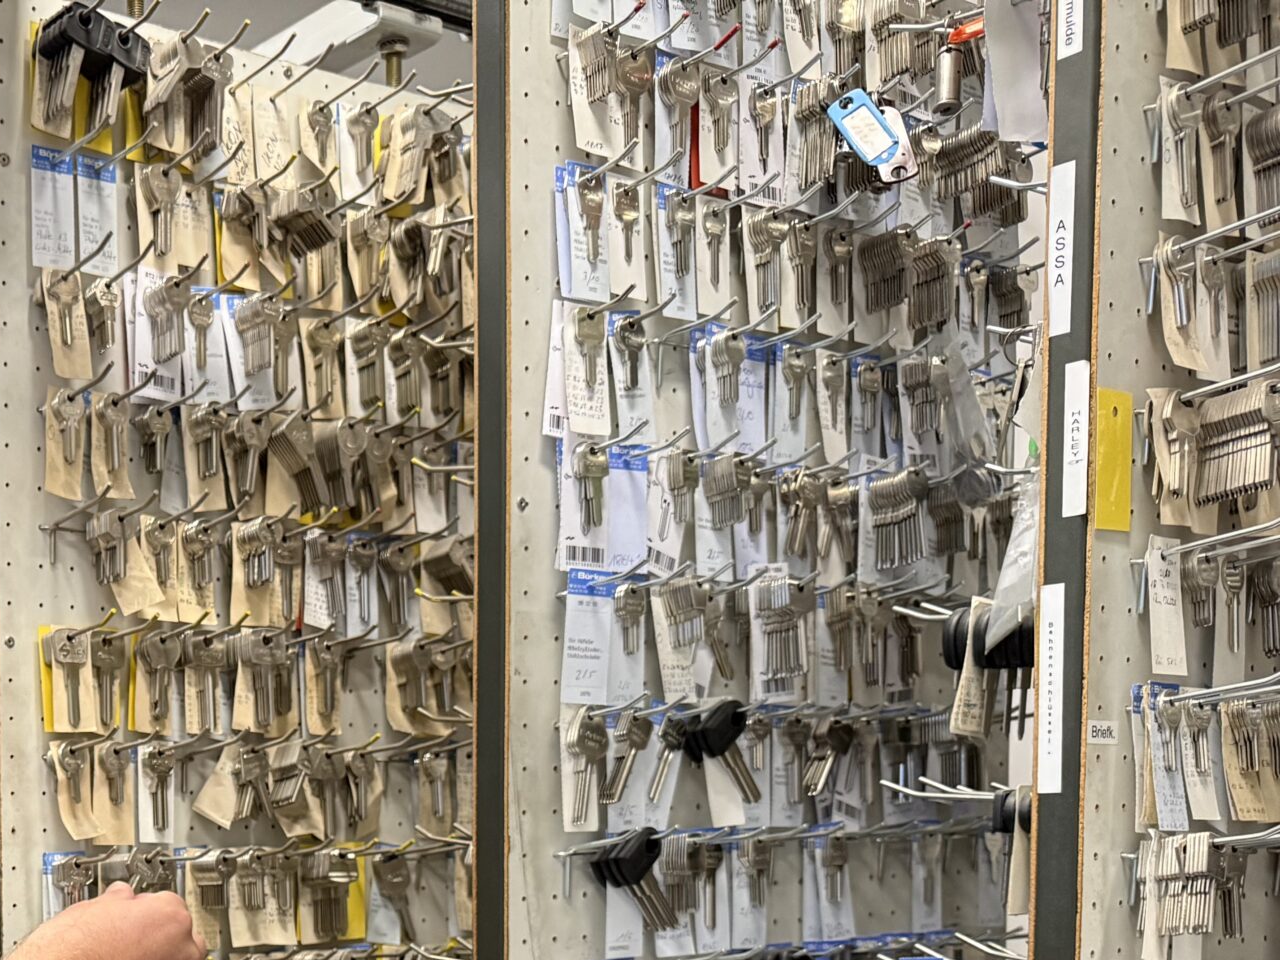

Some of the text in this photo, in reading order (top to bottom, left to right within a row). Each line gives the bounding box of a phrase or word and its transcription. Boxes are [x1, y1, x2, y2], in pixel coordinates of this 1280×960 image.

[1054, 219, 1067, 288] ASSA
[1071, 409, 1081, 457] HARLEY
[1091, 724, 1116, 739] Briefk.
